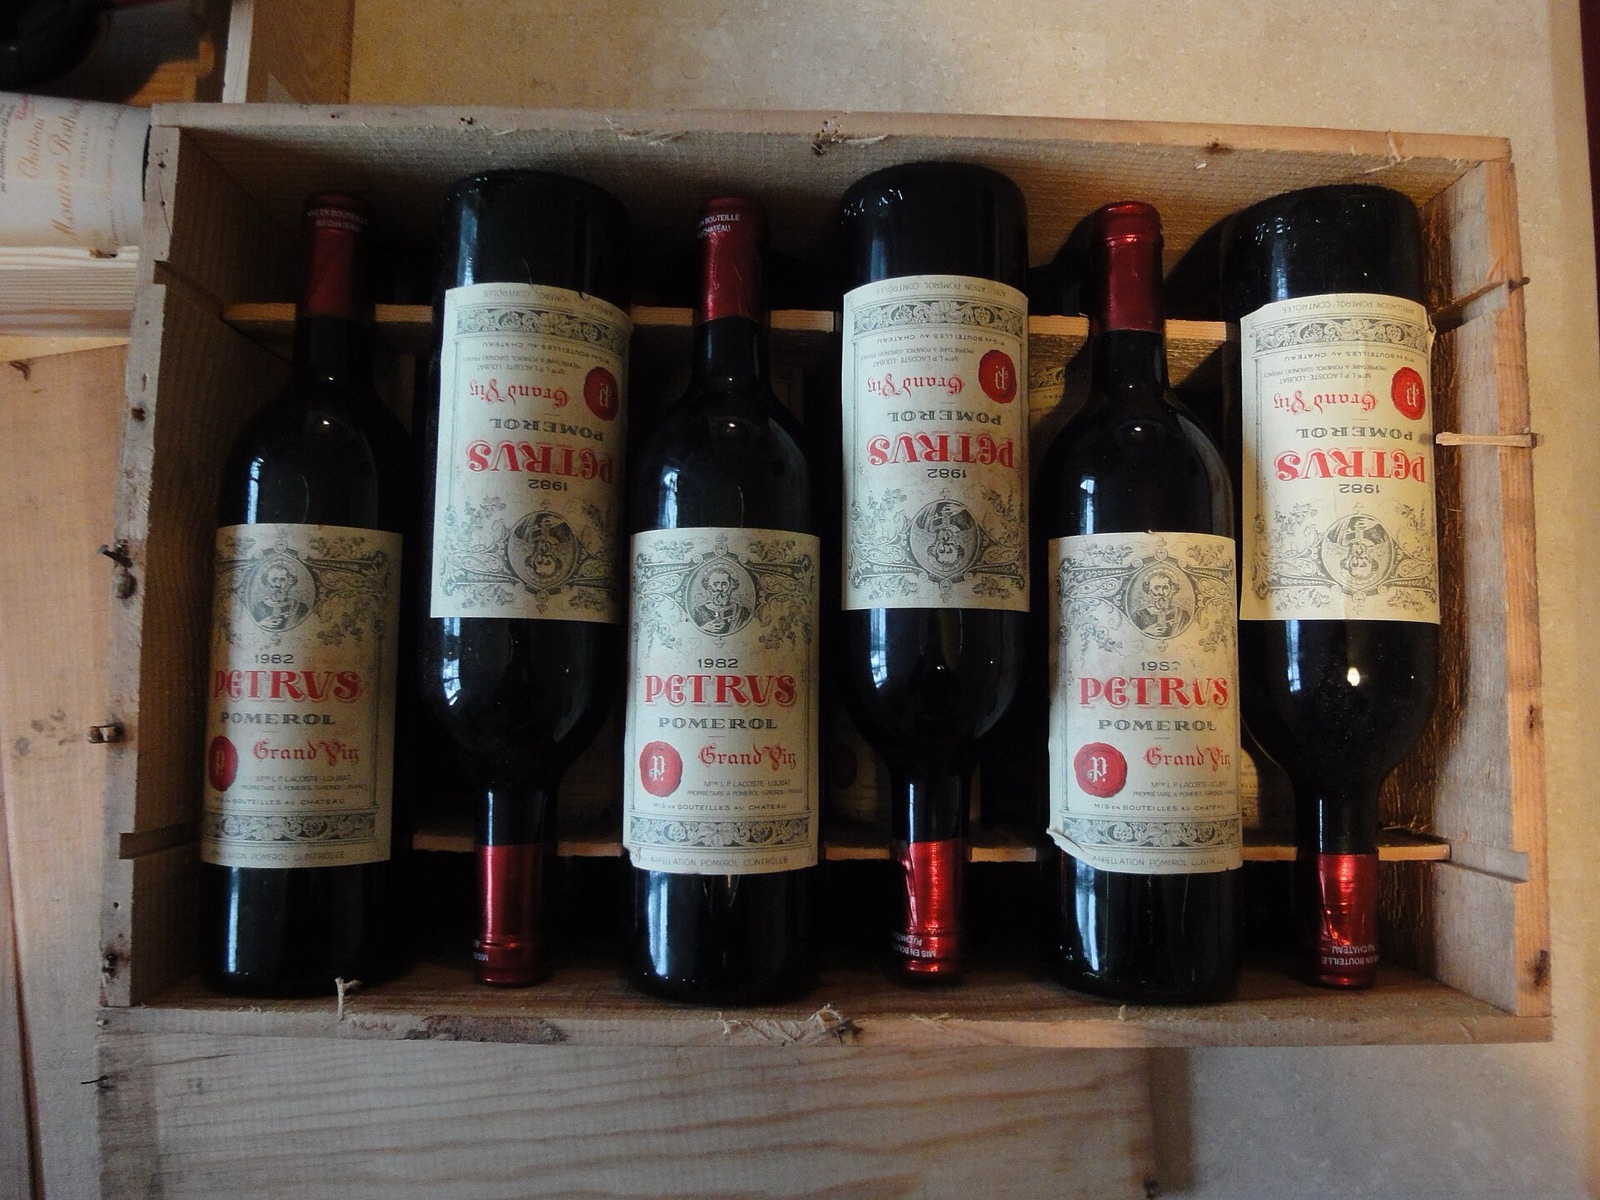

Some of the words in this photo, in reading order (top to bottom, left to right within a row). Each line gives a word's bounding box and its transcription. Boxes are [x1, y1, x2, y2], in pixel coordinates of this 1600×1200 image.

[704, 213, 741, 225] BOUTEILLE
[1336, 300, 1373, 308] POMEROL
[876, 335, 915, 345] CHATEAU
[932, 333, 983, 343] BOUTEILLES
[1284, 352, 1327, 362] CHATEAU
[1345, 351, 1395, 360] BOUTEILLES
[887, 410, 1002, 426] POMEROL
[489, 418, 603, 442] POMEROL
[1296, 427, 1413, 441] POMEROL
[927, 468, 967, 479] 1982
[528, 479, 568, 492] 1982
[1338, 484, 1380, 494] 1982
[255, 653, 295, 665] 1982
[697, 658, 739, 669] 1982
[220, 712, 335, 726] POMEROL
[658, 717, 778, 729] POMEROL
[1098, 719, 1217, 731] POMEROL
[677, 803, 731, 811] BOUTEILLES
[1093, 802, 1110, 810] MIS
[1122, 804, 1178, 812] BOUTEILLES
[909, 947, 920, 957] EN
[921, 950, 937, 958] MIS
[1331, 945, 1368, 954] CHATEAU
[1321, 957, 1365, 966] BOUTEILLE
